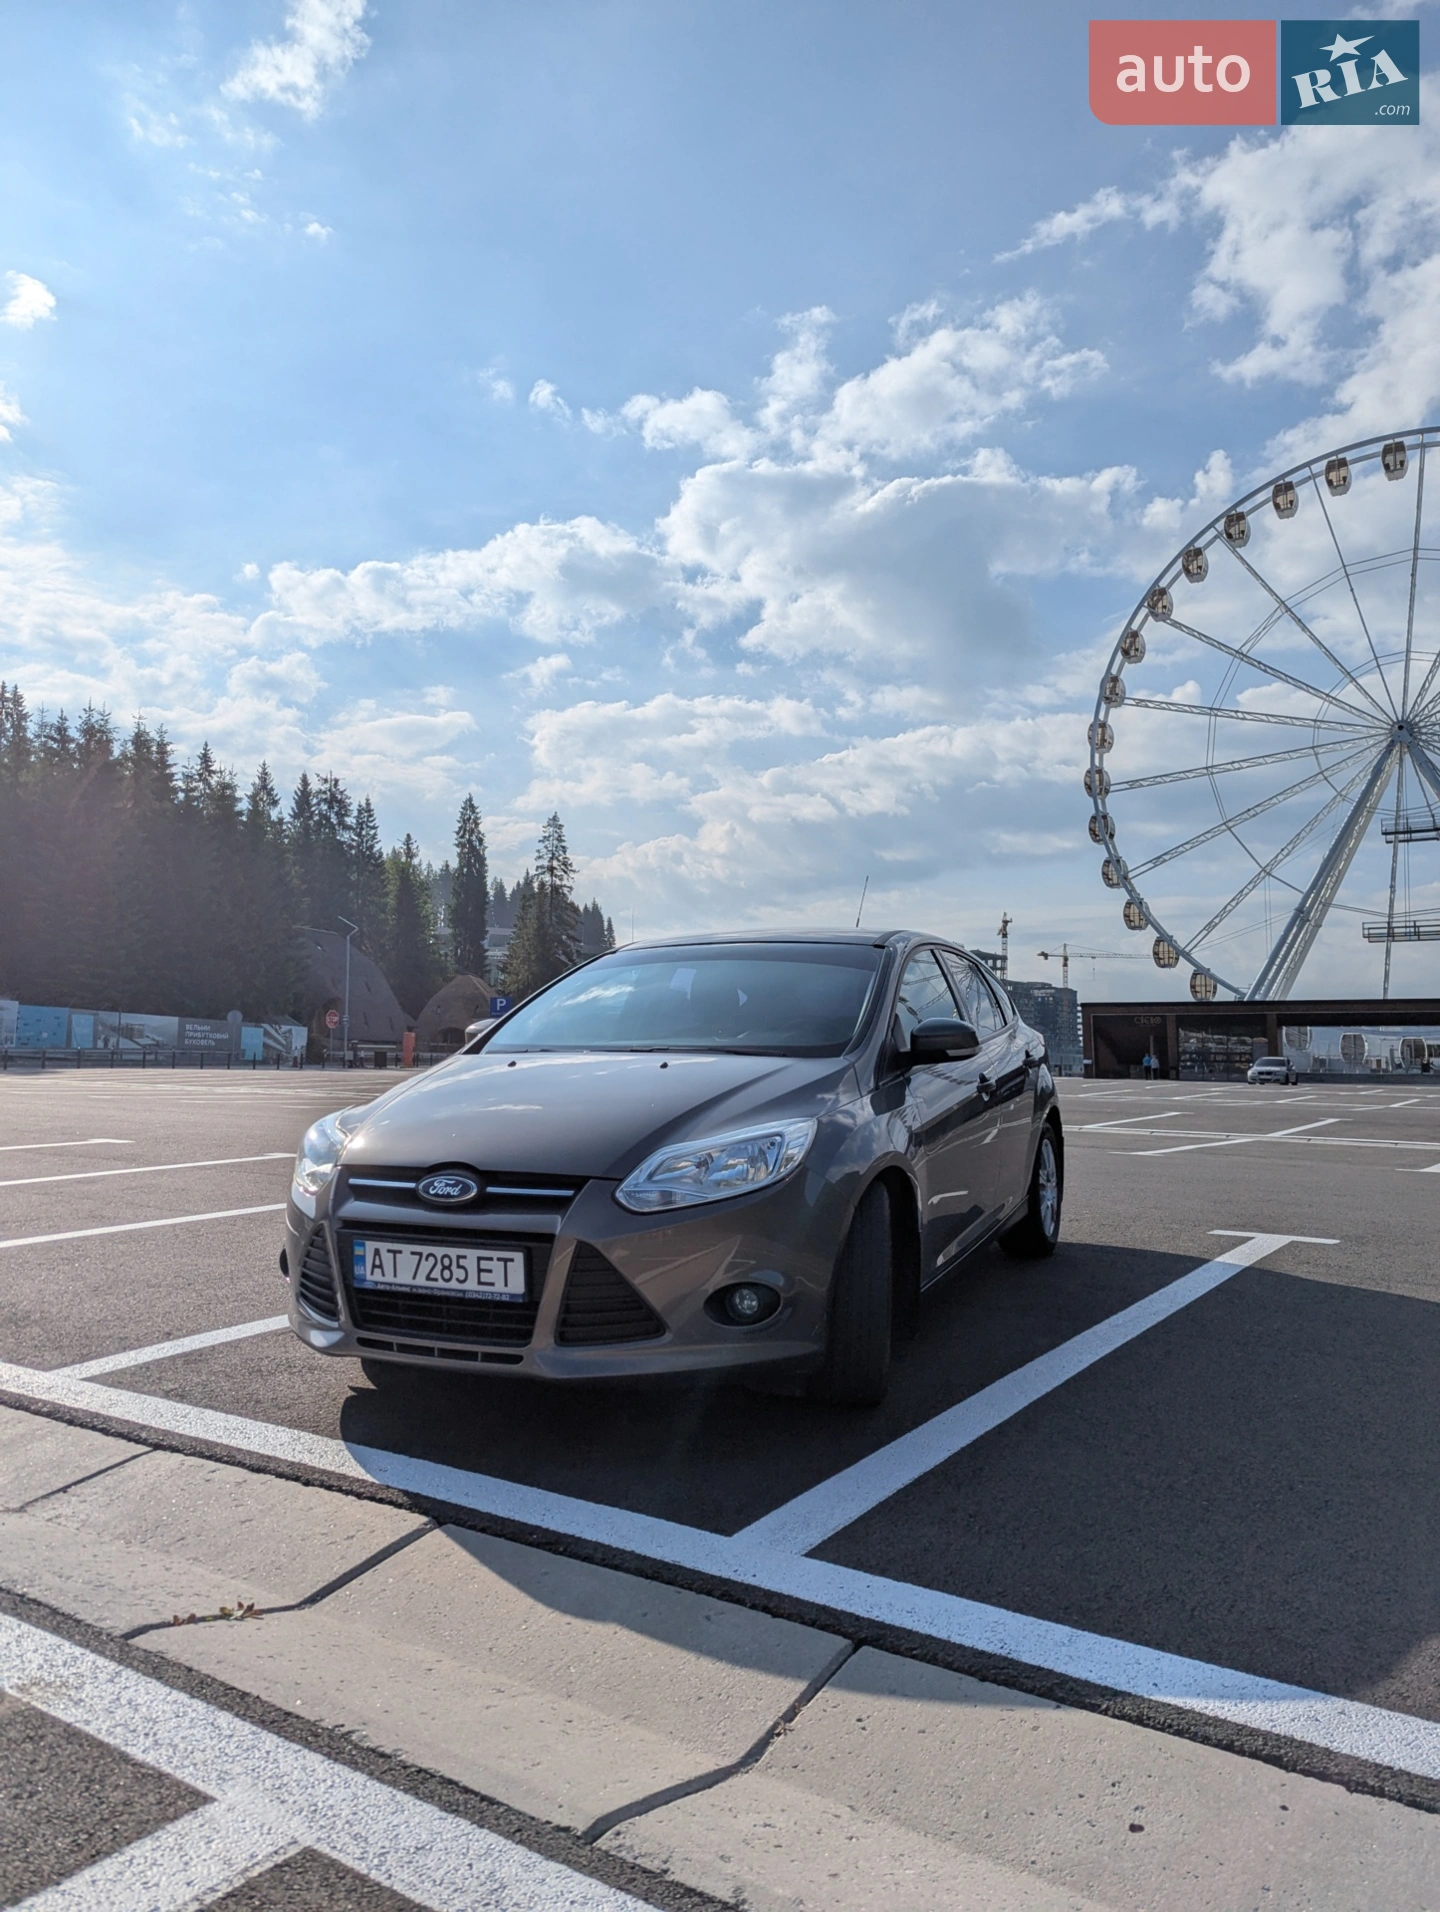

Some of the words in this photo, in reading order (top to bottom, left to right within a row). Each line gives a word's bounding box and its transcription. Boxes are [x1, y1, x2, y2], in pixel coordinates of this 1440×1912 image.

[496, 998, 507, 1011] P
[184, 1031, 229, 1039] ПРИБУТКОВИЙ
[429, 1179, 463, 1196] Ford
[354, 1265, 366, 1275] UA
[370, 1248, 403, 1278] AT
[410, 1251, 469, 1284] 7285
[476, 1256, 515, 1288] ET
